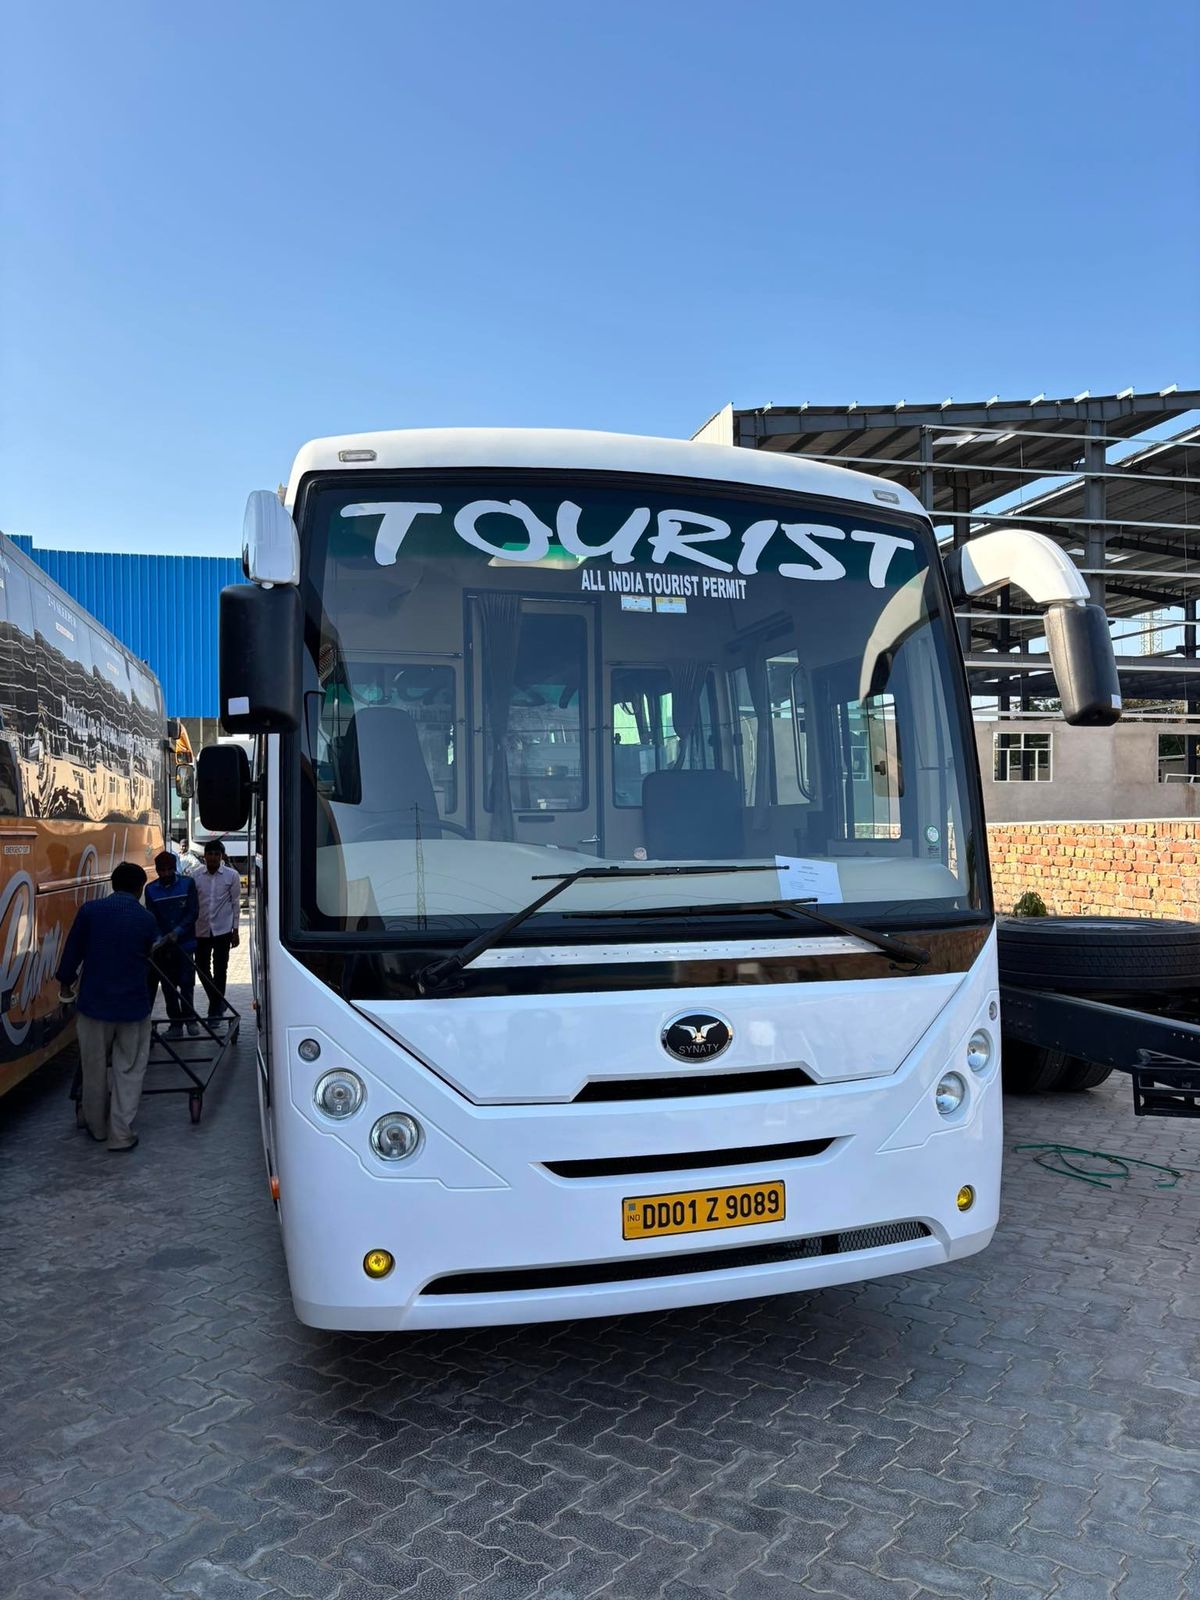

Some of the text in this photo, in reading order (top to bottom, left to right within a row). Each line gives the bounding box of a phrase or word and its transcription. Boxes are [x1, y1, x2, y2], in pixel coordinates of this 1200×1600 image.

[340, 499, 915, 589] TOURIST
[581, 569, 747, 600] ALL INDIA TOURIST PERMIT
[678, 1042, 720, 1055] SYNATY
[642, 1189, 780, 1230] DD01 Z 9089
